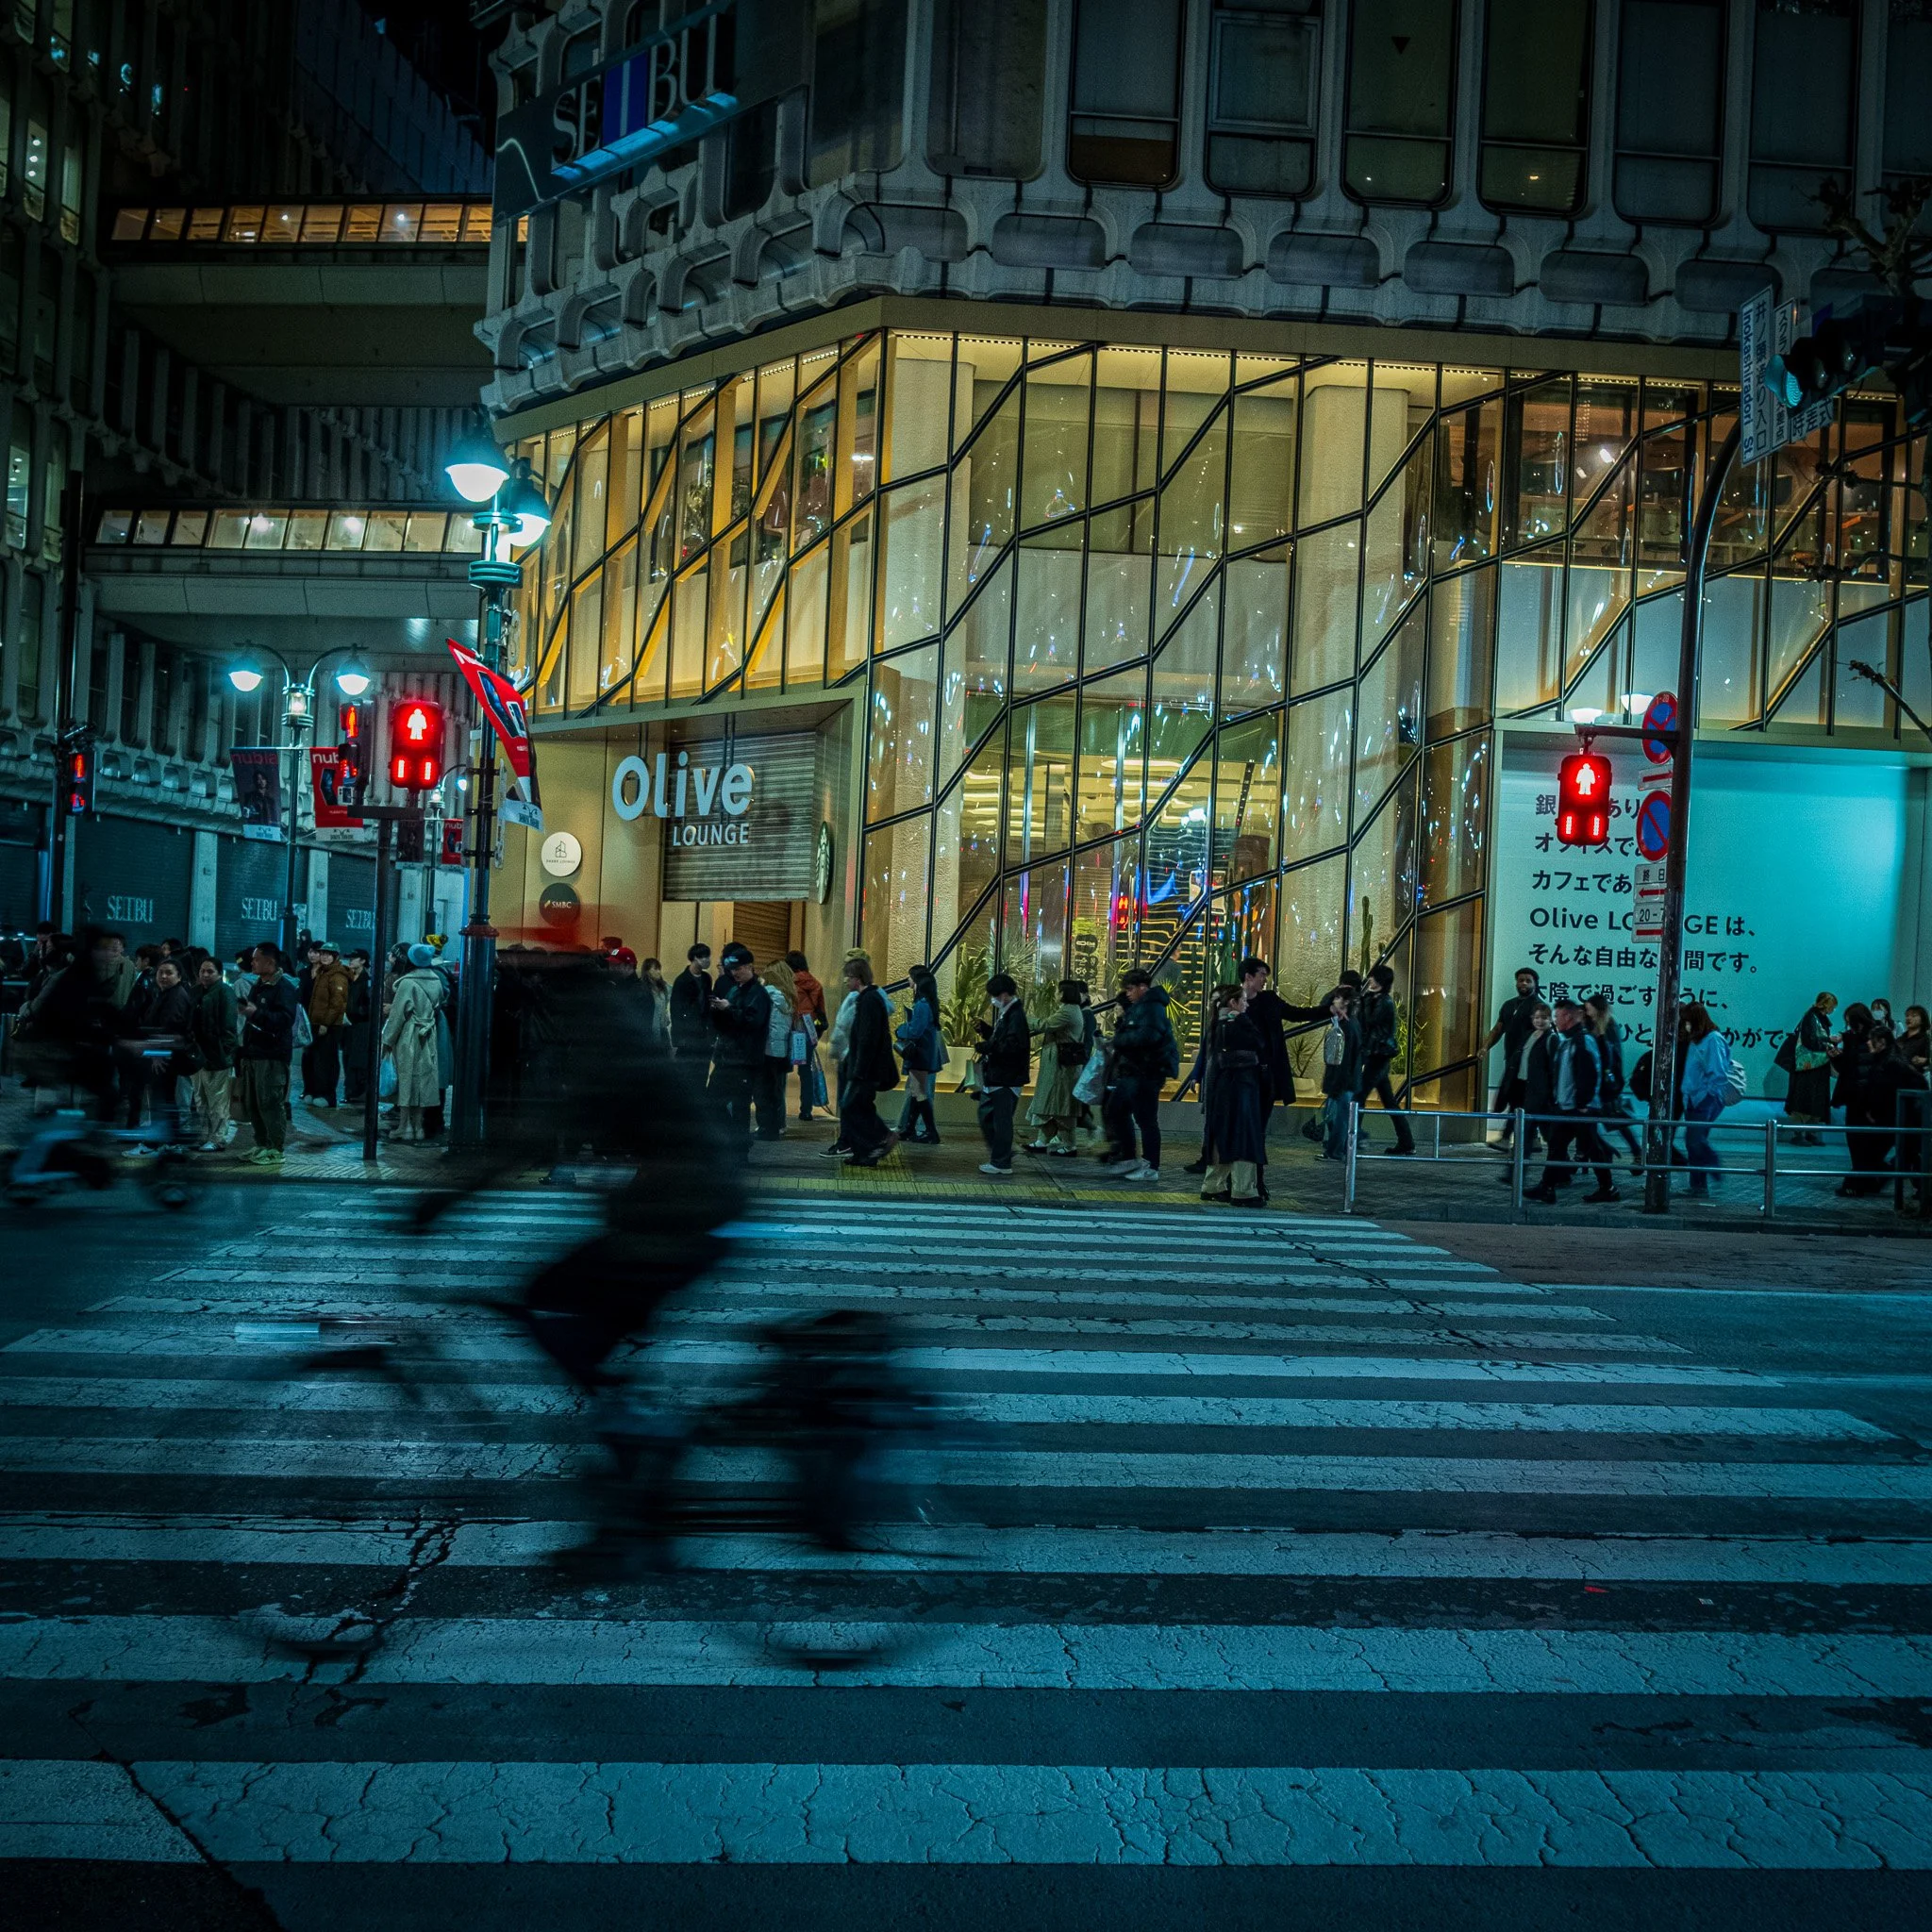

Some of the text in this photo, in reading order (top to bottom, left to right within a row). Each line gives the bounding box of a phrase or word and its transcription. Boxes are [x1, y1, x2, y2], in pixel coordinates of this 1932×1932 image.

[552, 13, 717, 165] SEIBU
[1743, 308, 1754, 425] Inokashiradori
[232, 752, 277, 764] nubia
[312, 752, 340, 764] nub
[612, 751, 756, 821] Olive
[1536, 794, 1641, 819] 銀あり
[672, 823, 750, 846] LOUNGE
[107, 895, 154, 924] SEIBU
[241, 897, 277, 921] SEIBU
[551, 901, 573, 909] SMBC
[1529, 908, 1598, 929] Olive
[1608, 910, 1718, 935] LOGE
[1529, 943, 1758, 974] そんな自由な間です。
[1536, 982, 1728, 1009] 木陰で過ごすうに、
